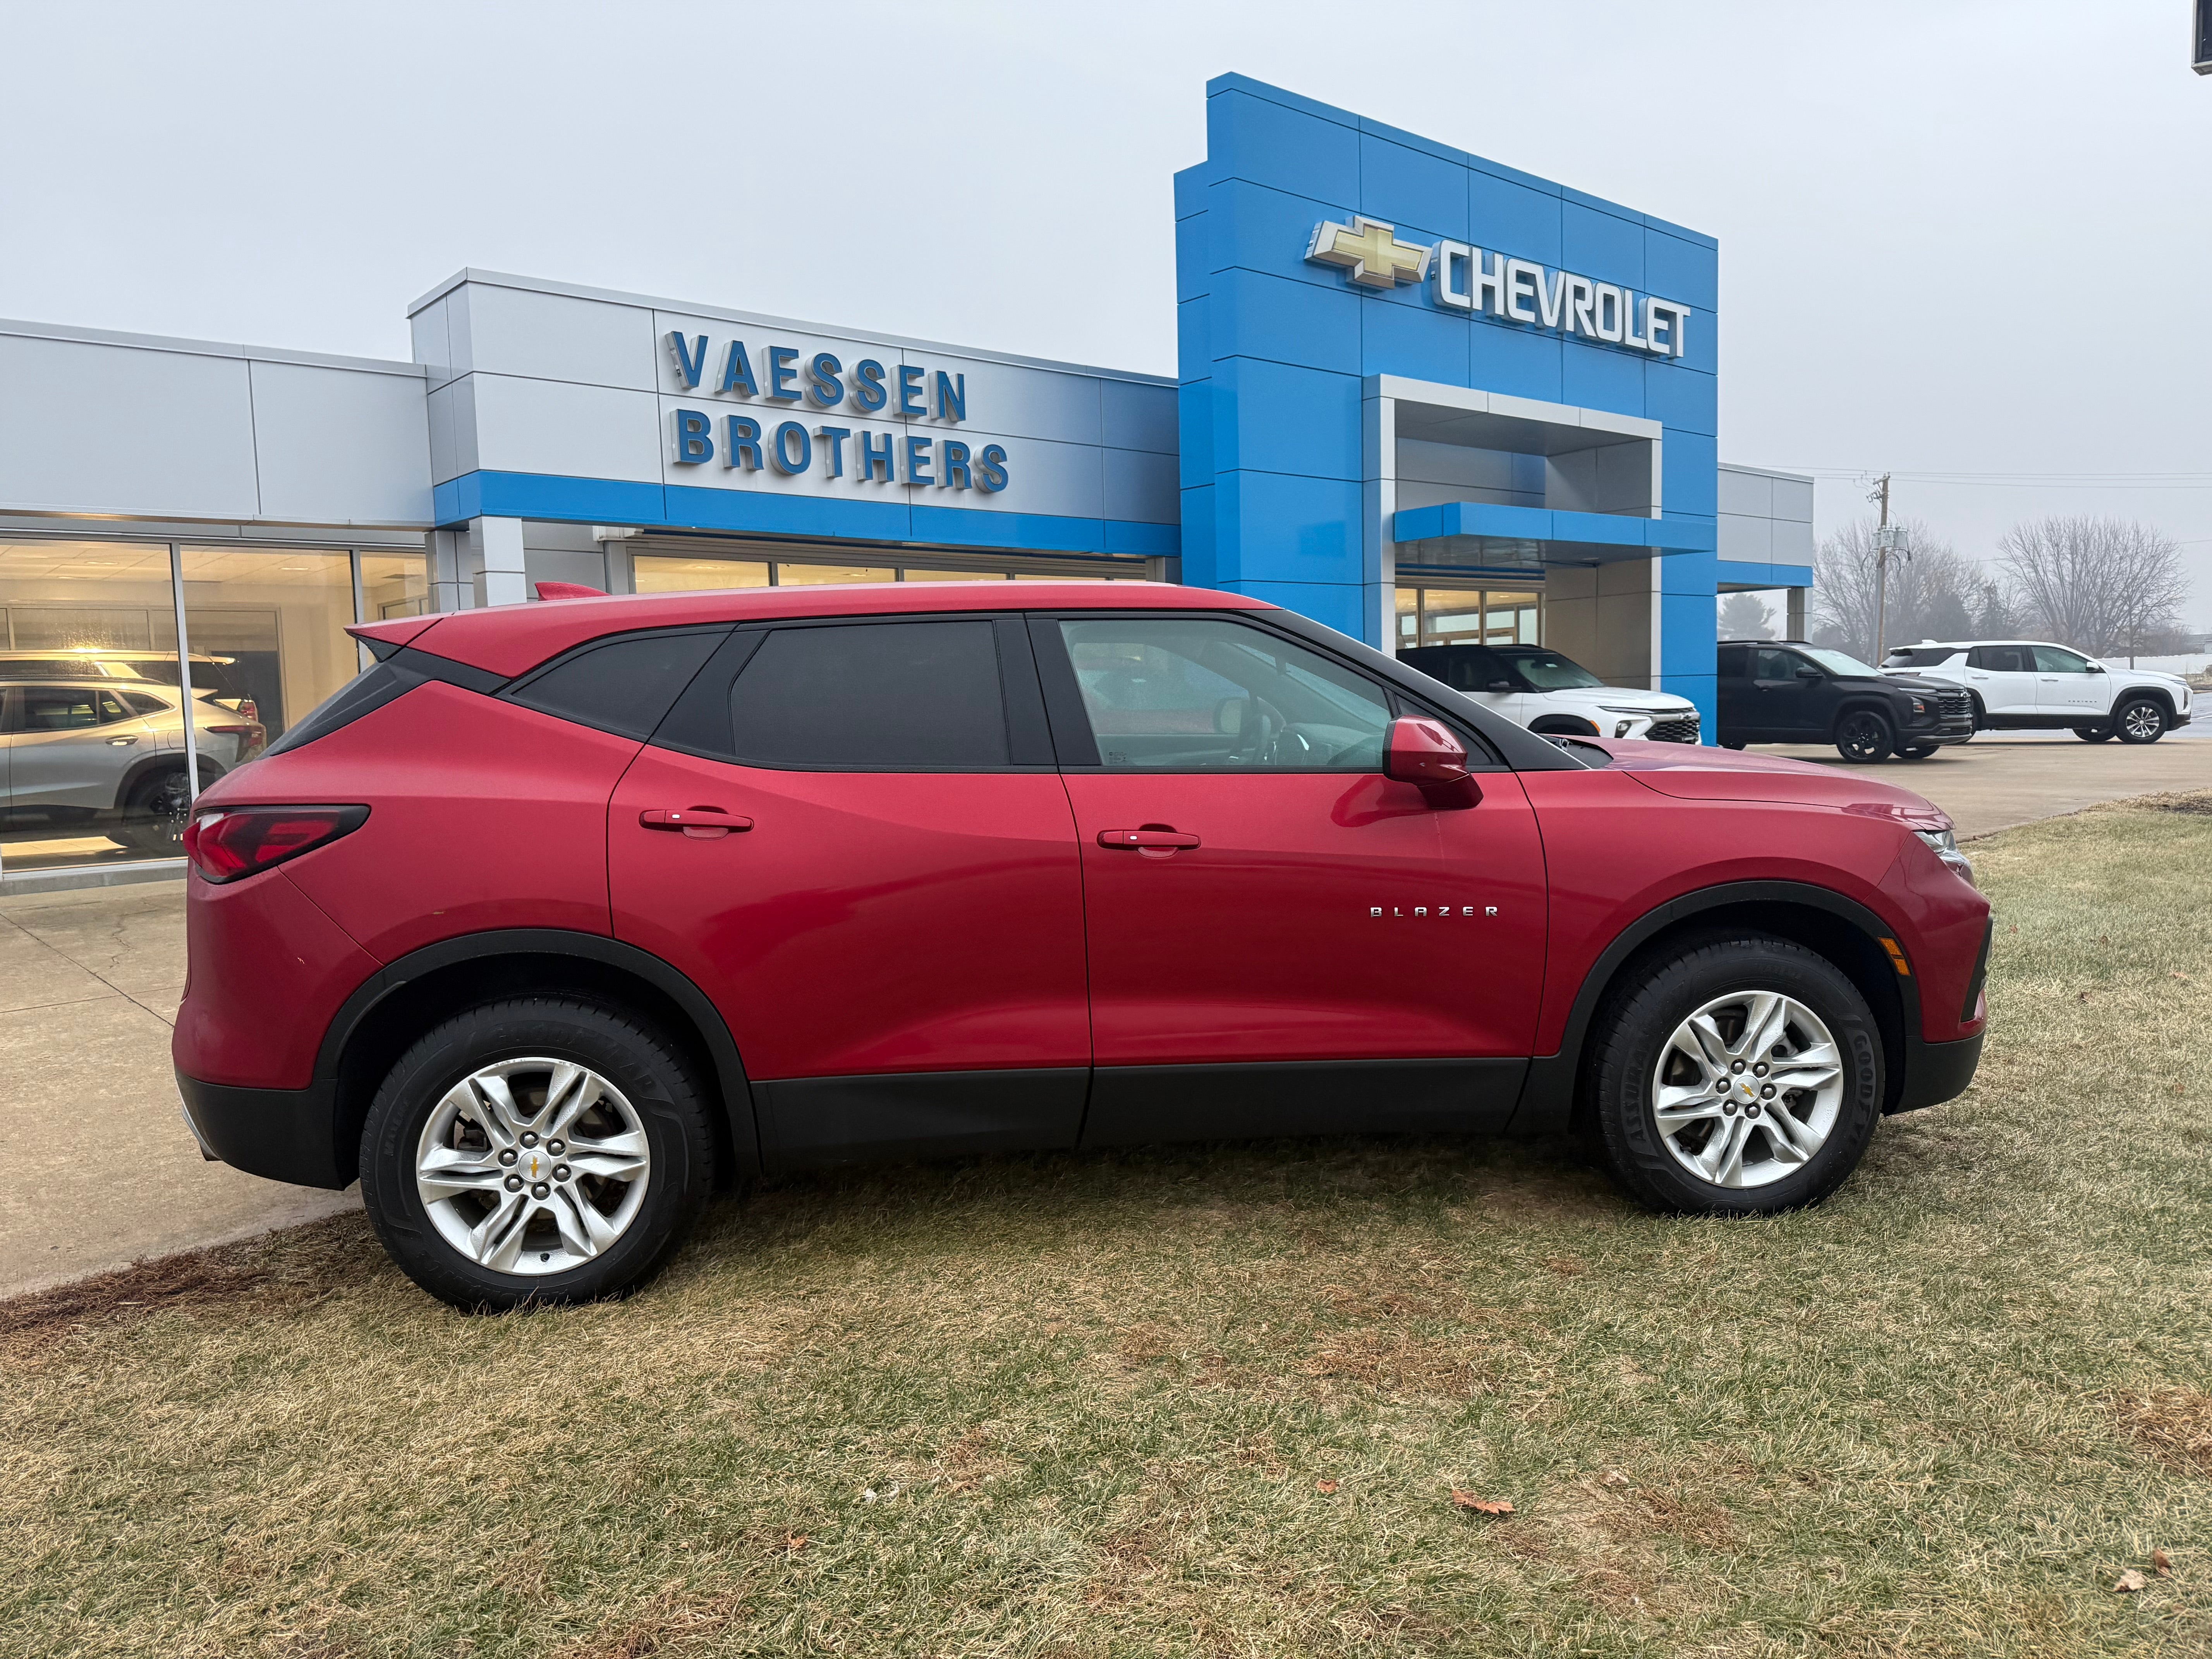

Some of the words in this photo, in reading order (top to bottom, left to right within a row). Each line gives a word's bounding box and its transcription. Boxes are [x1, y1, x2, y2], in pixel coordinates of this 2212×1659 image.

[1432, 239, 1691, 358] CHEVROLET
[665, 331, 966, 422] VAESSEN
[670, 408, 1008, 493] BROTHERS
[1370, 906, 1498, 918] BLAZER
